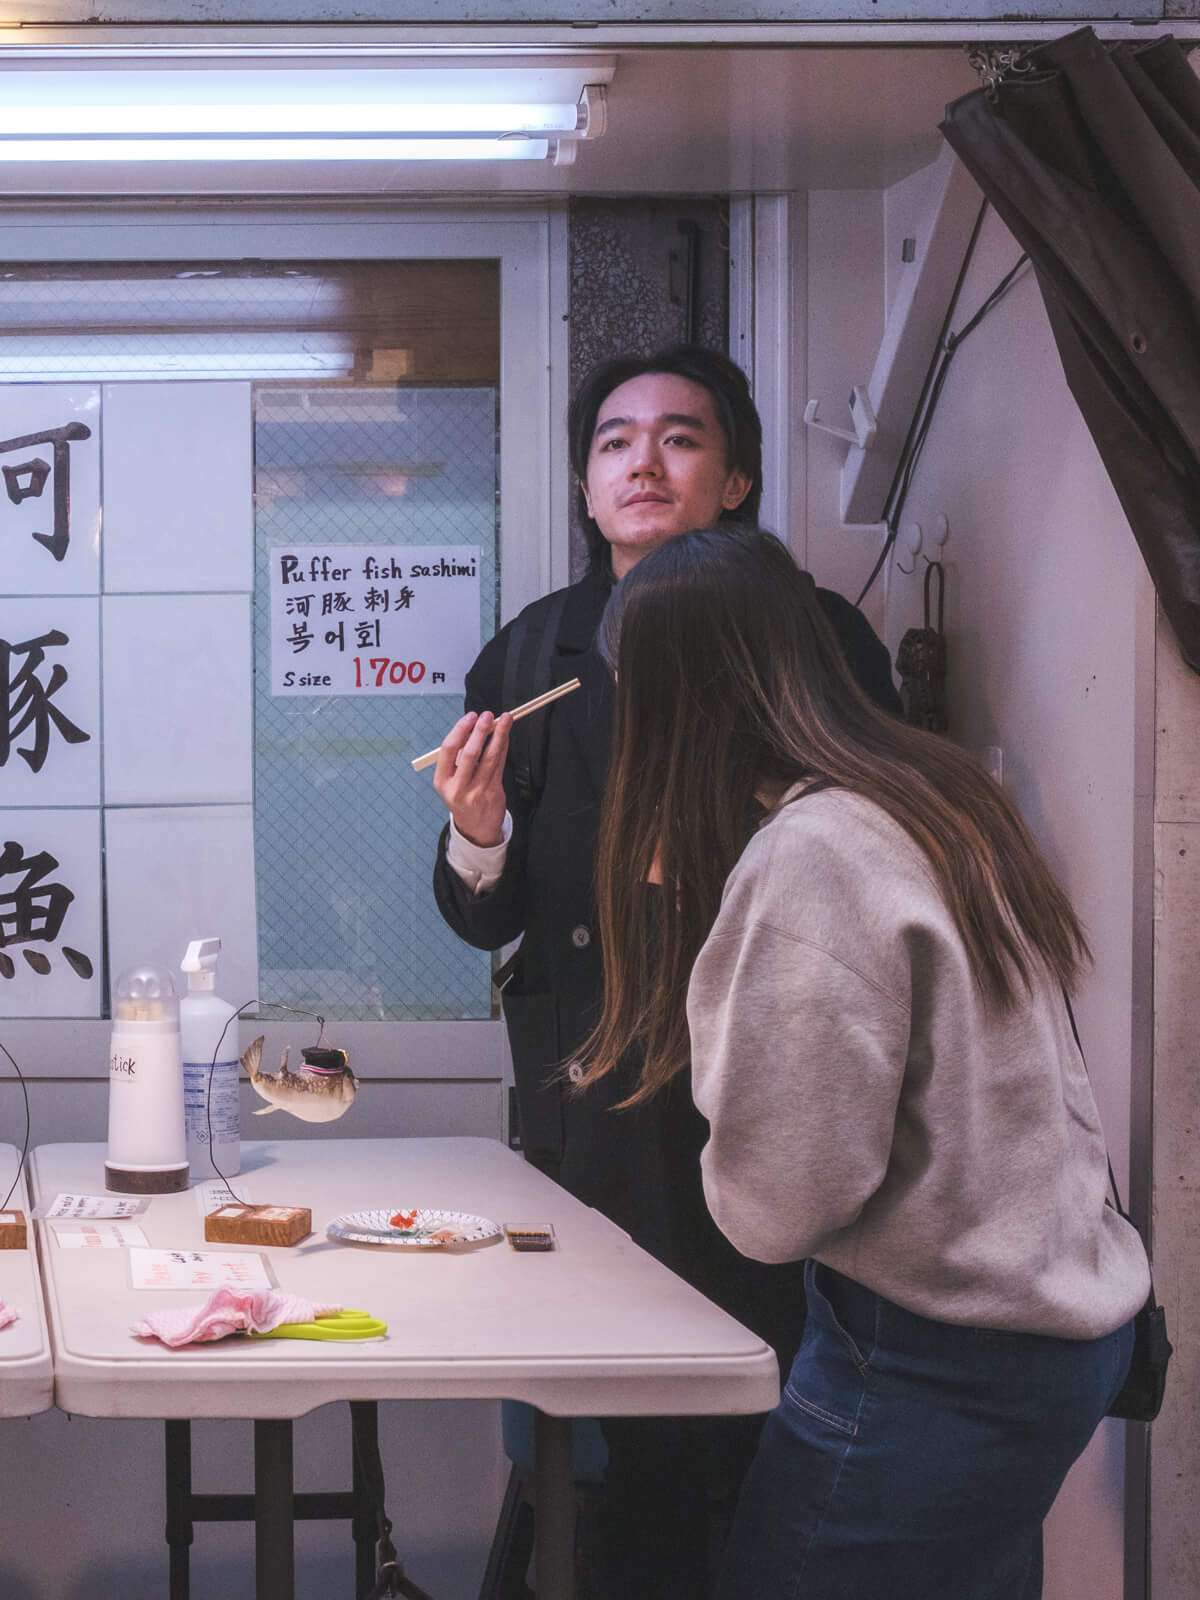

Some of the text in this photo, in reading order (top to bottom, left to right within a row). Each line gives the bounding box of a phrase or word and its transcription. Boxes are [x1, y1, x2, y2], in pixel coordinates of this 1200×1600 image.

[280, 555, 476, 584] Puffer fish sashimi
[282, 672, 296, 687] S
[298, 672, 332, 687] size
